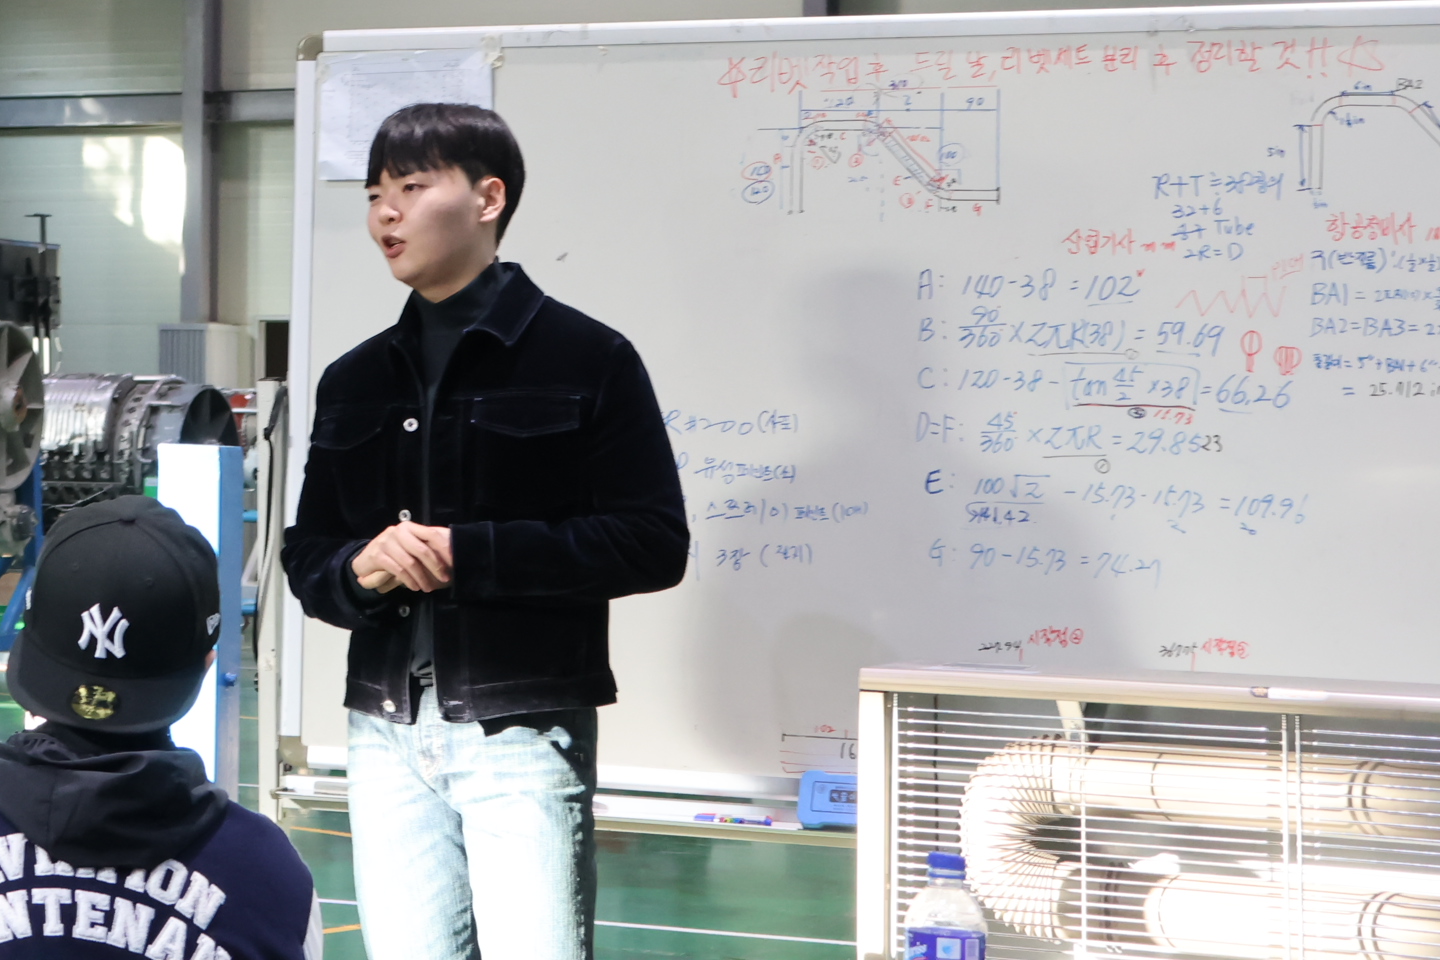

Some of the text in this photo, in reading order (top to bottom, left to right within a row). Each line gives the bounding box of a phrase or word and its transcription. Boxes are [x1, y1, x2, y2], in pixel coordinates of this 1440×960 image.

[750, 50, 808, 95] 리벳
[812, 53, 860, 85] 작업
[865, 51, 888, 82] 후
[909, 50, 958, 81] 드릴
[1213, 215, 1256, 236] Tube
[78, 603, 130, 659] NY
